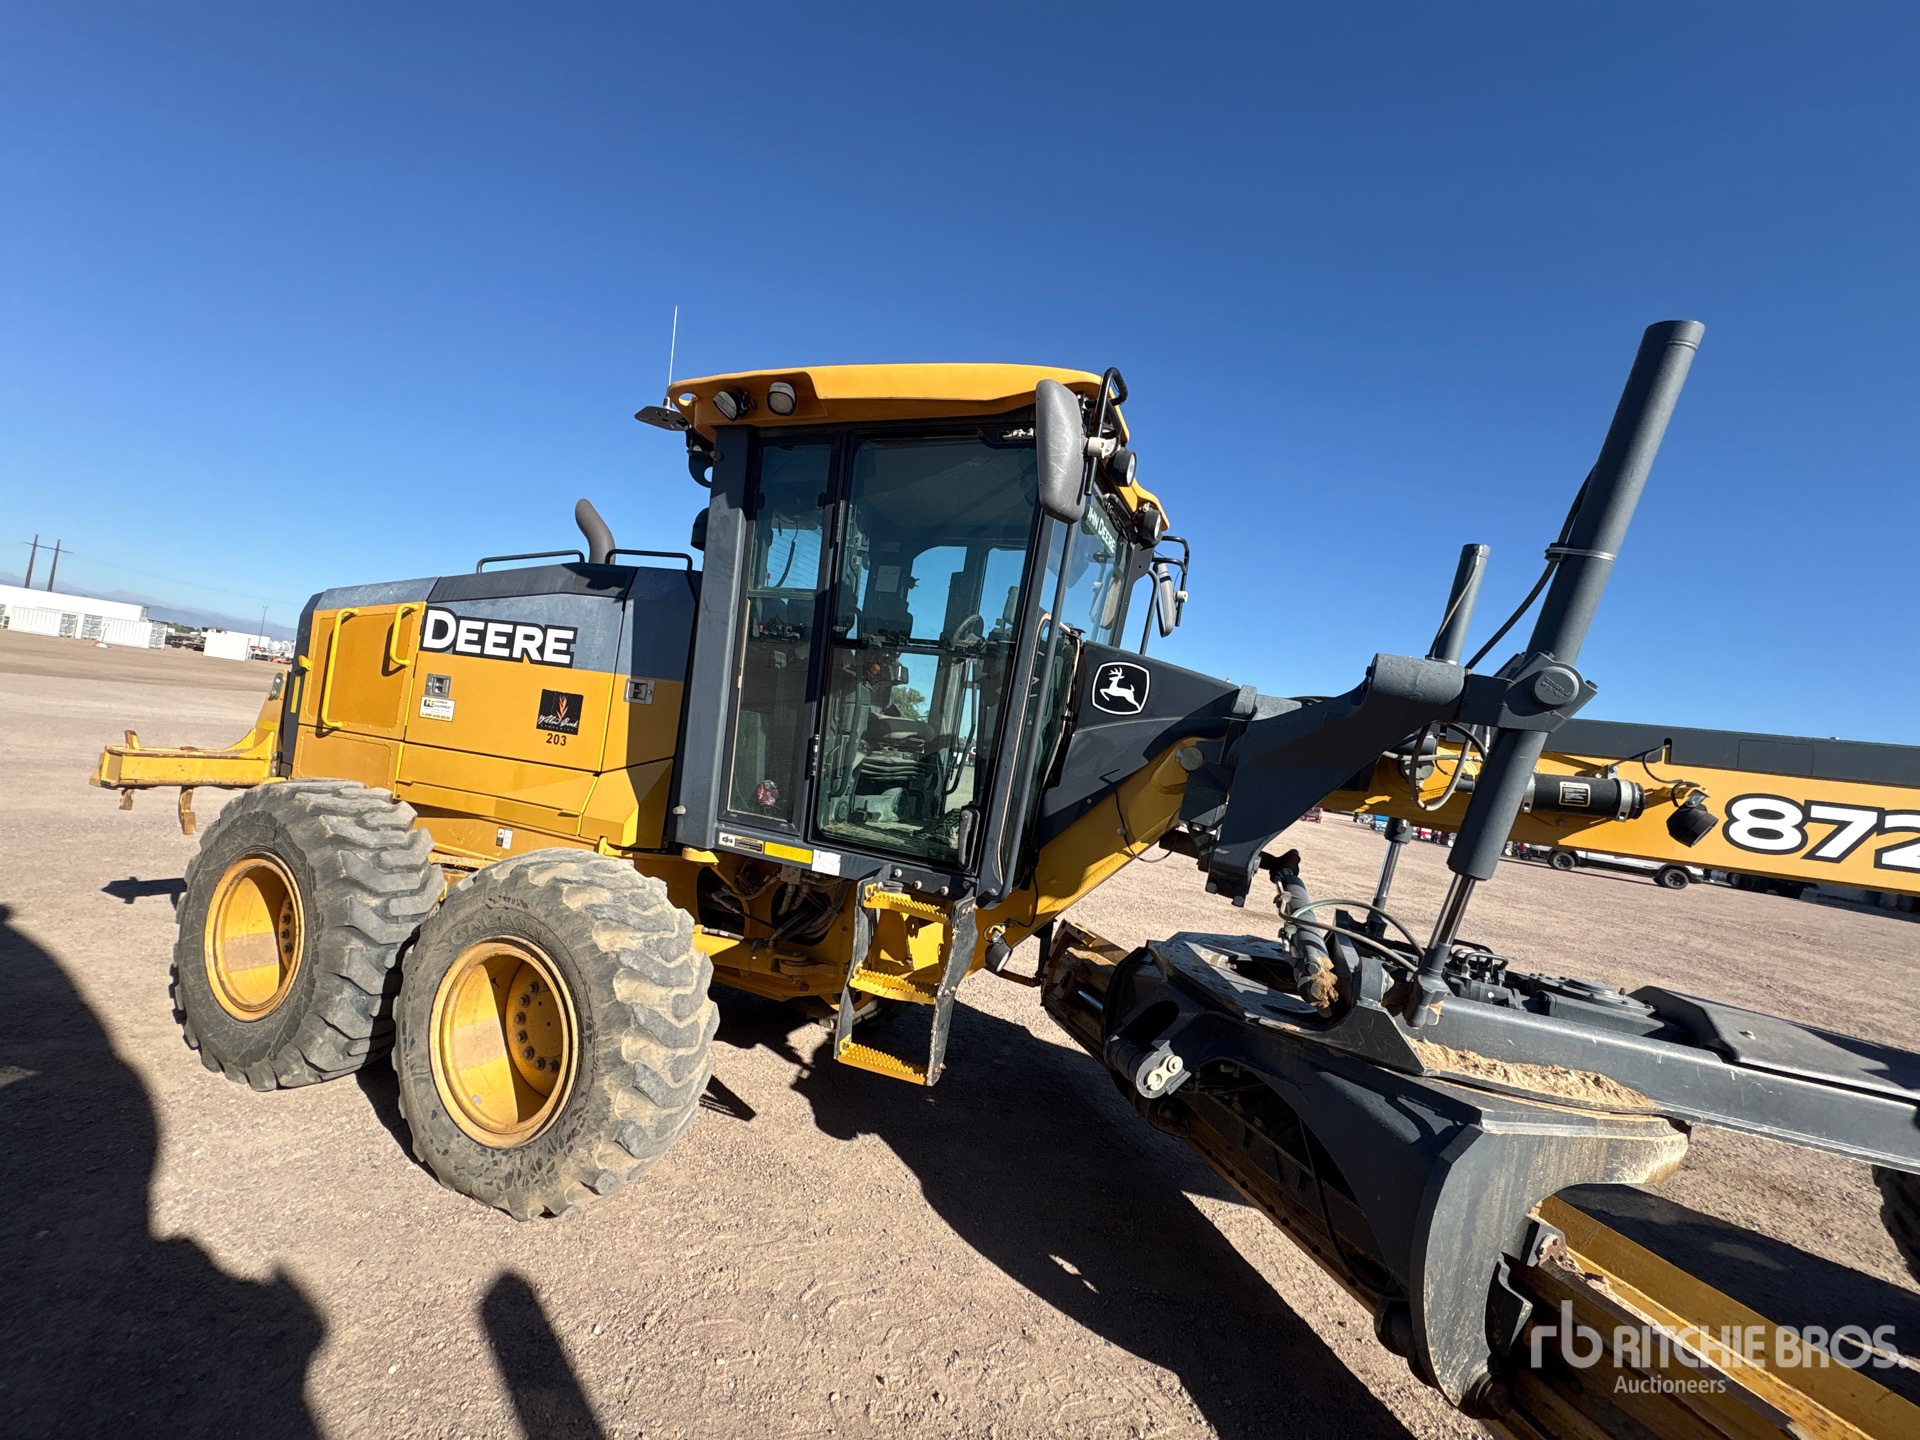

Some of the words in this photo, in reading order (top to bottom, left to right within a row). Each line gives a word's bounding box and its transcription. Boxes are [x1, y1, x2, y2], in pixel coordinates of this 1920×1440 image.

[1098, 517, 1116, 553] DEERE
[421, 608, 575, 666] DEERE
[545, 732, 567, 746] 203
[1724, 794, 1920, 873] 872
